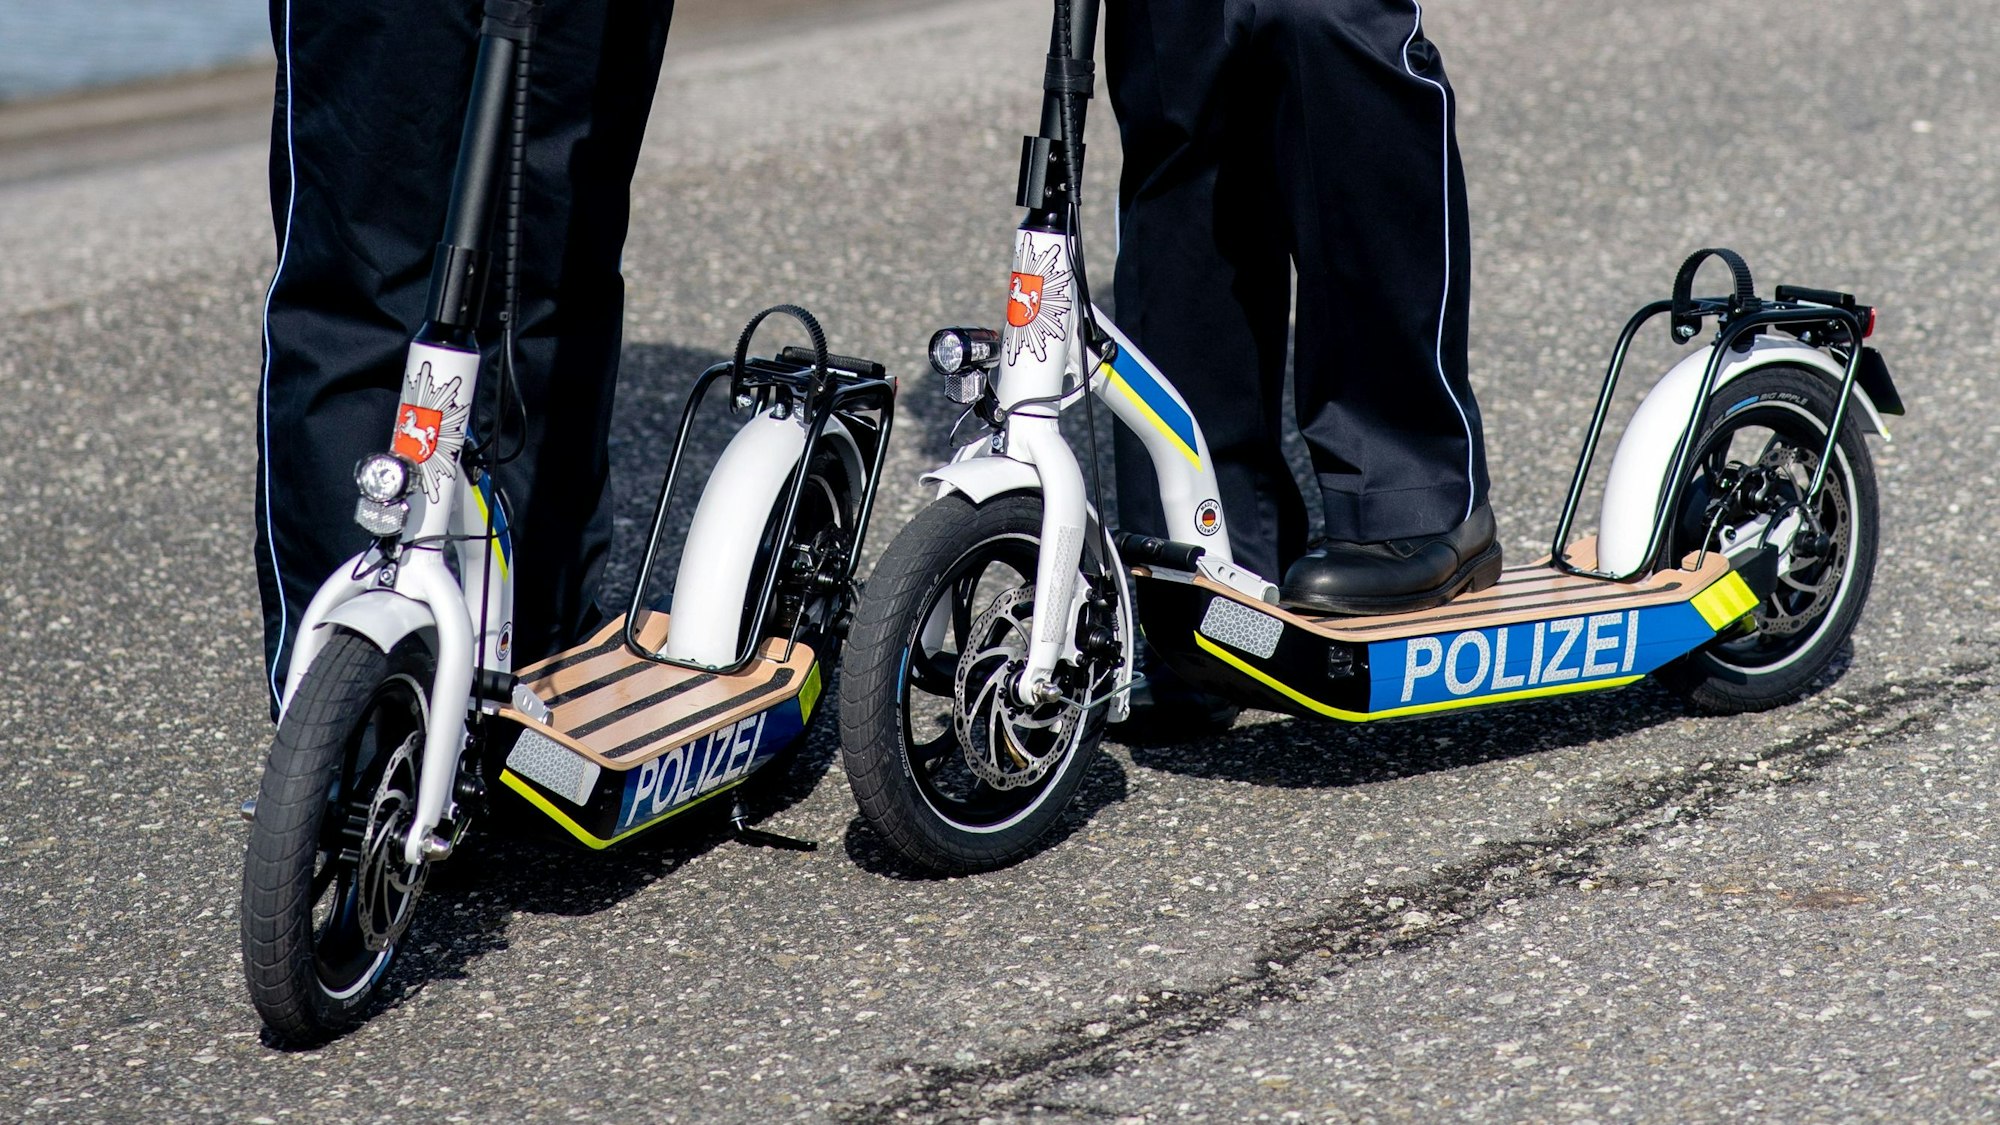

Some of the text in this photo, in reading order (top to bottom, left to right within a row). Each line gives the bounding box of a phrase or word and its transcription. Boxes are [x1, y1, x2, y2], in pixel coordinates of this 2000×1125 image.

[1760, 392, 1808, 405] BIG APPLE
[1400, 609, 1640, 703] POLIZEI
[624, 711, 768, 828] POLIZEI
